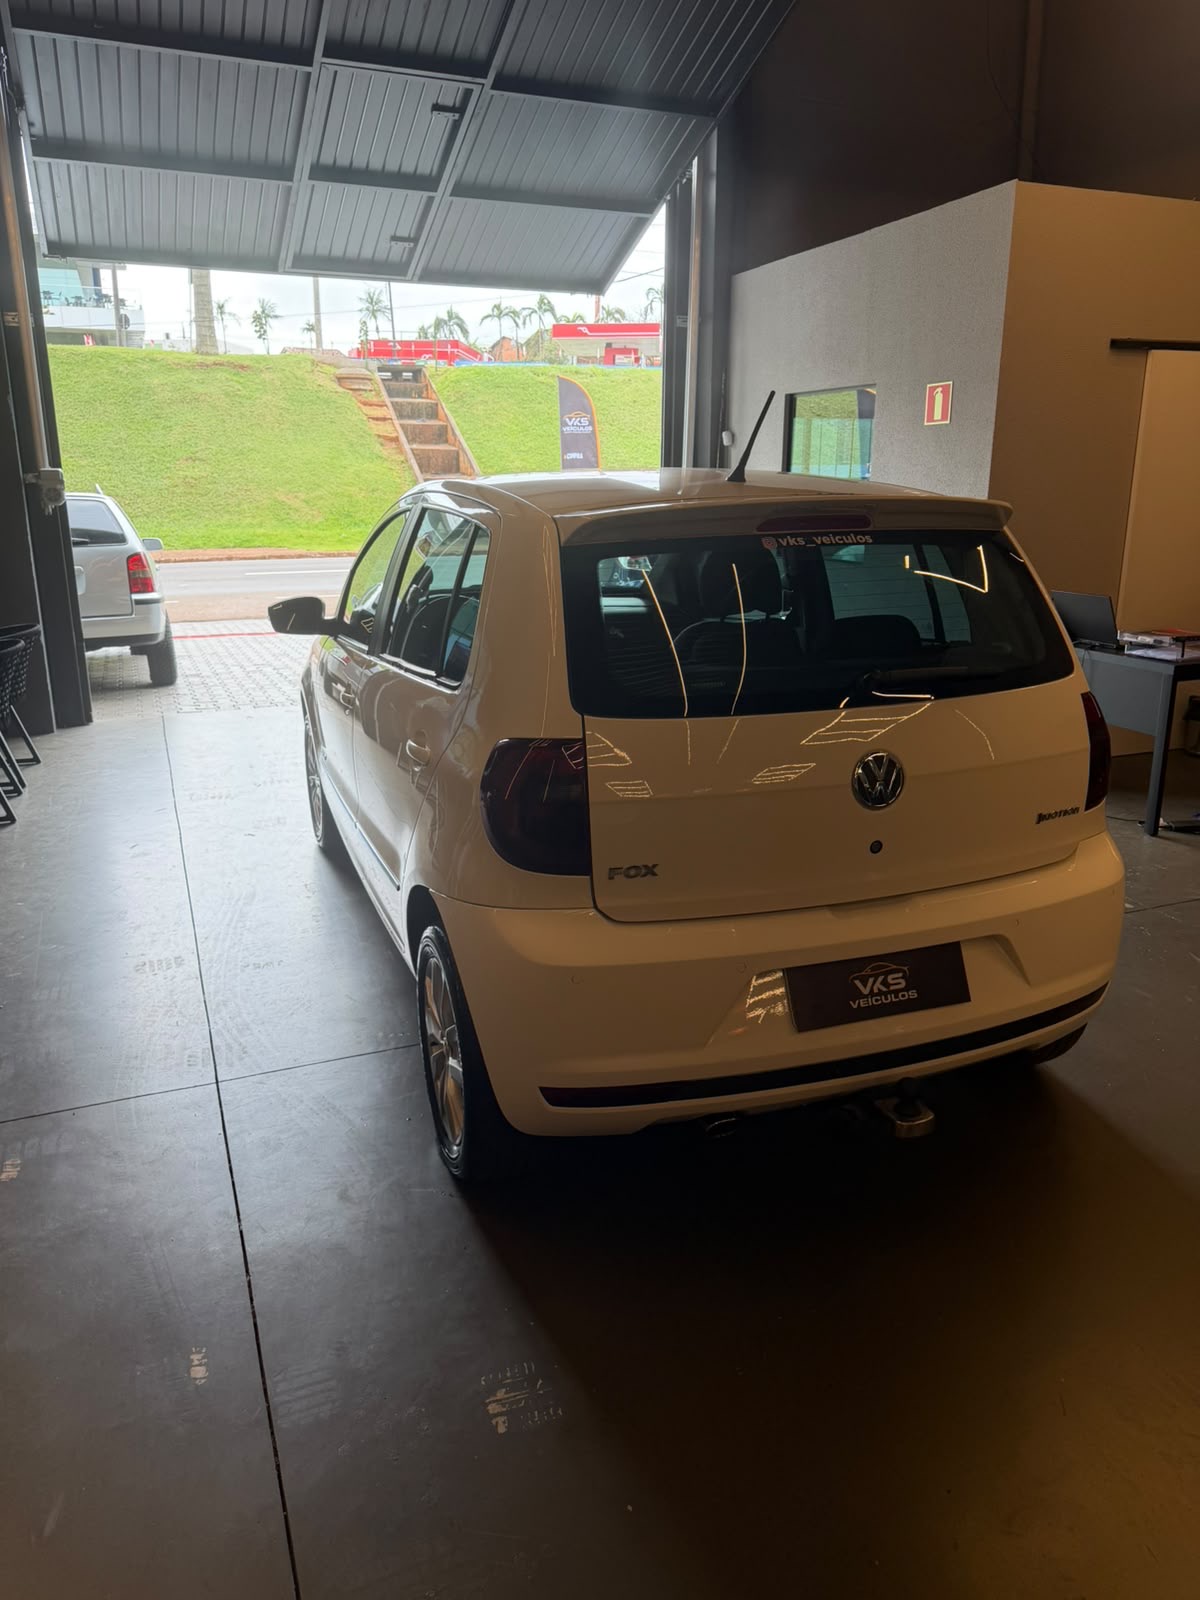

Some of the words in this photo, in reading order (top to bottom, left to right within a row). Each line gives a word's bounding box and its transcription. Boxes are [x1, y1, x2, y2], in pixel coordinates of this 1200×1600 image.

[565, 417, 589, 426] VKS
[608, 863, 660, 880] FOX
[853, 972, 907, 995] VKS
